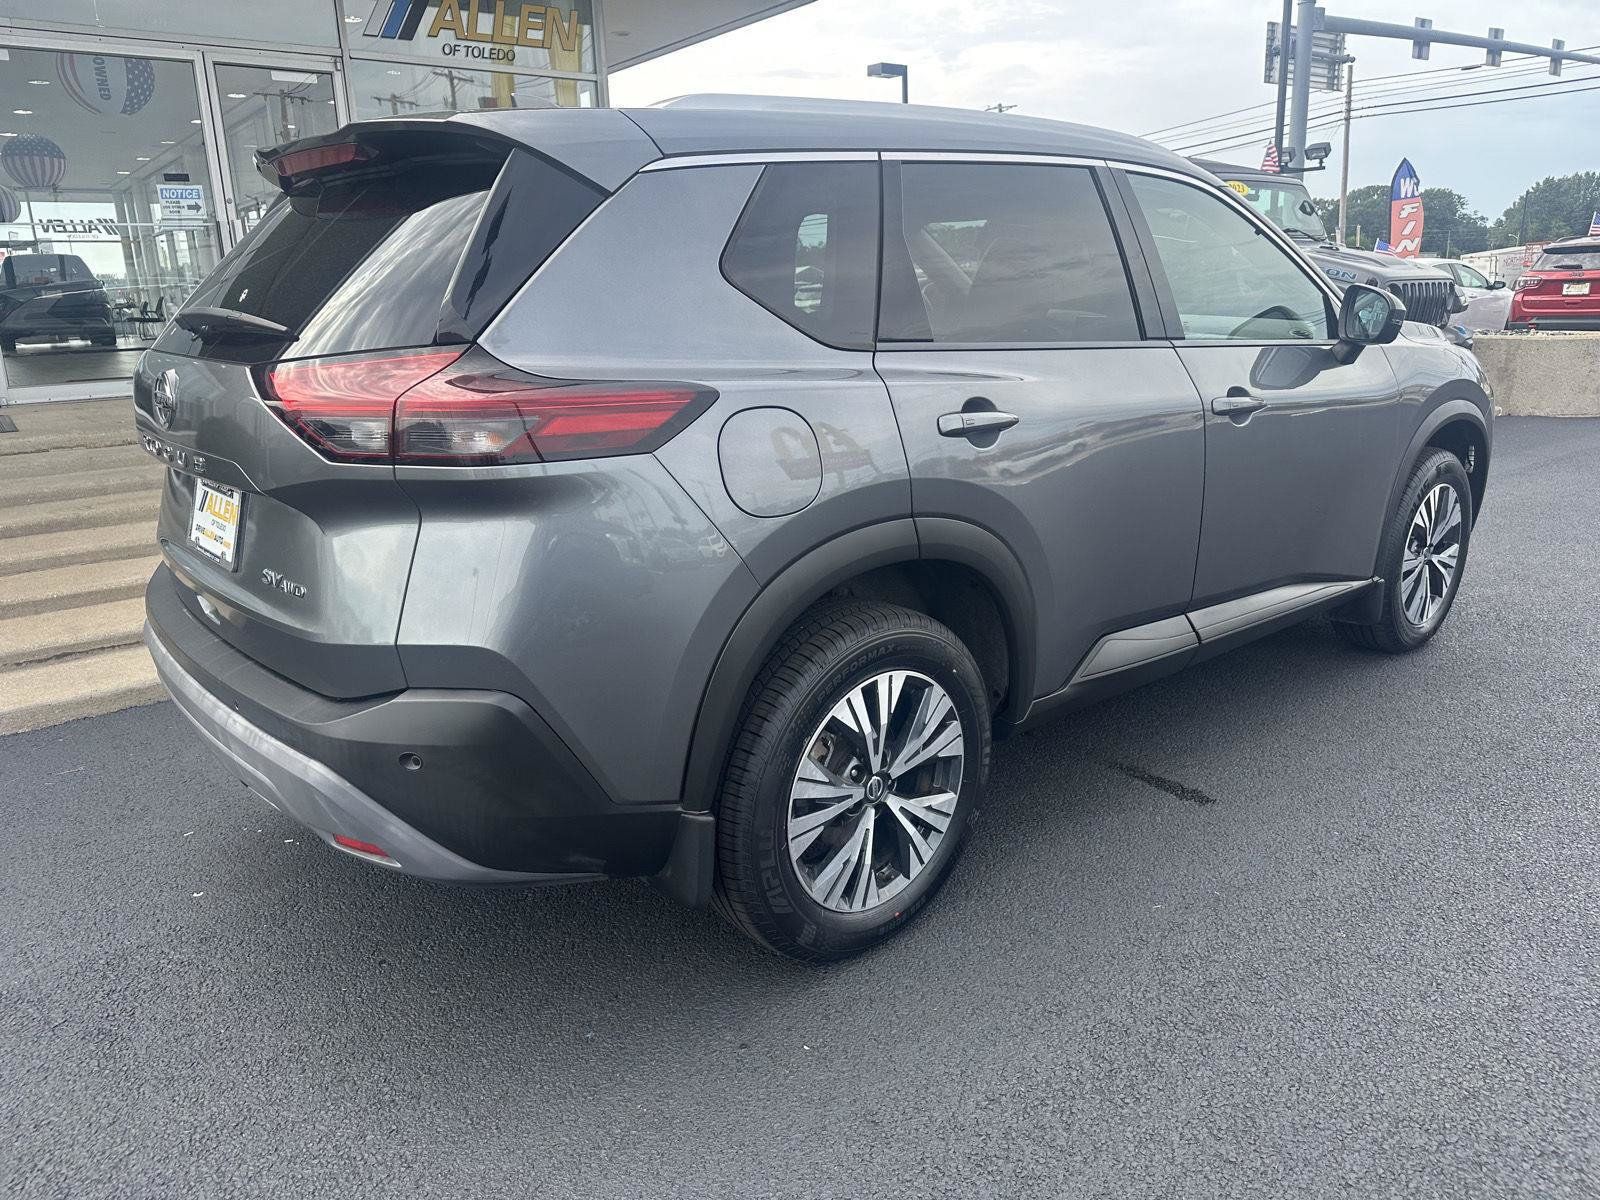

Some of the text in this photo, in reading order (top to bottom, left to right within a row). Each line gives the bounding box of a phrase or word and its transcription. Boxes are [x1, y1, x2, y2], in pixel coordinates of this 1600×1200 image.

[428, 0, 578, 51] ALLEN
[442, 43, 516, 62] OF TOLEDO
[162, 189, 199, 199] NOTICE
[205, 491, 239, 527] ALLEN
[262, 568, 307, 598] SV AWD
[816, 643, 896, 704] PERFORMAX
